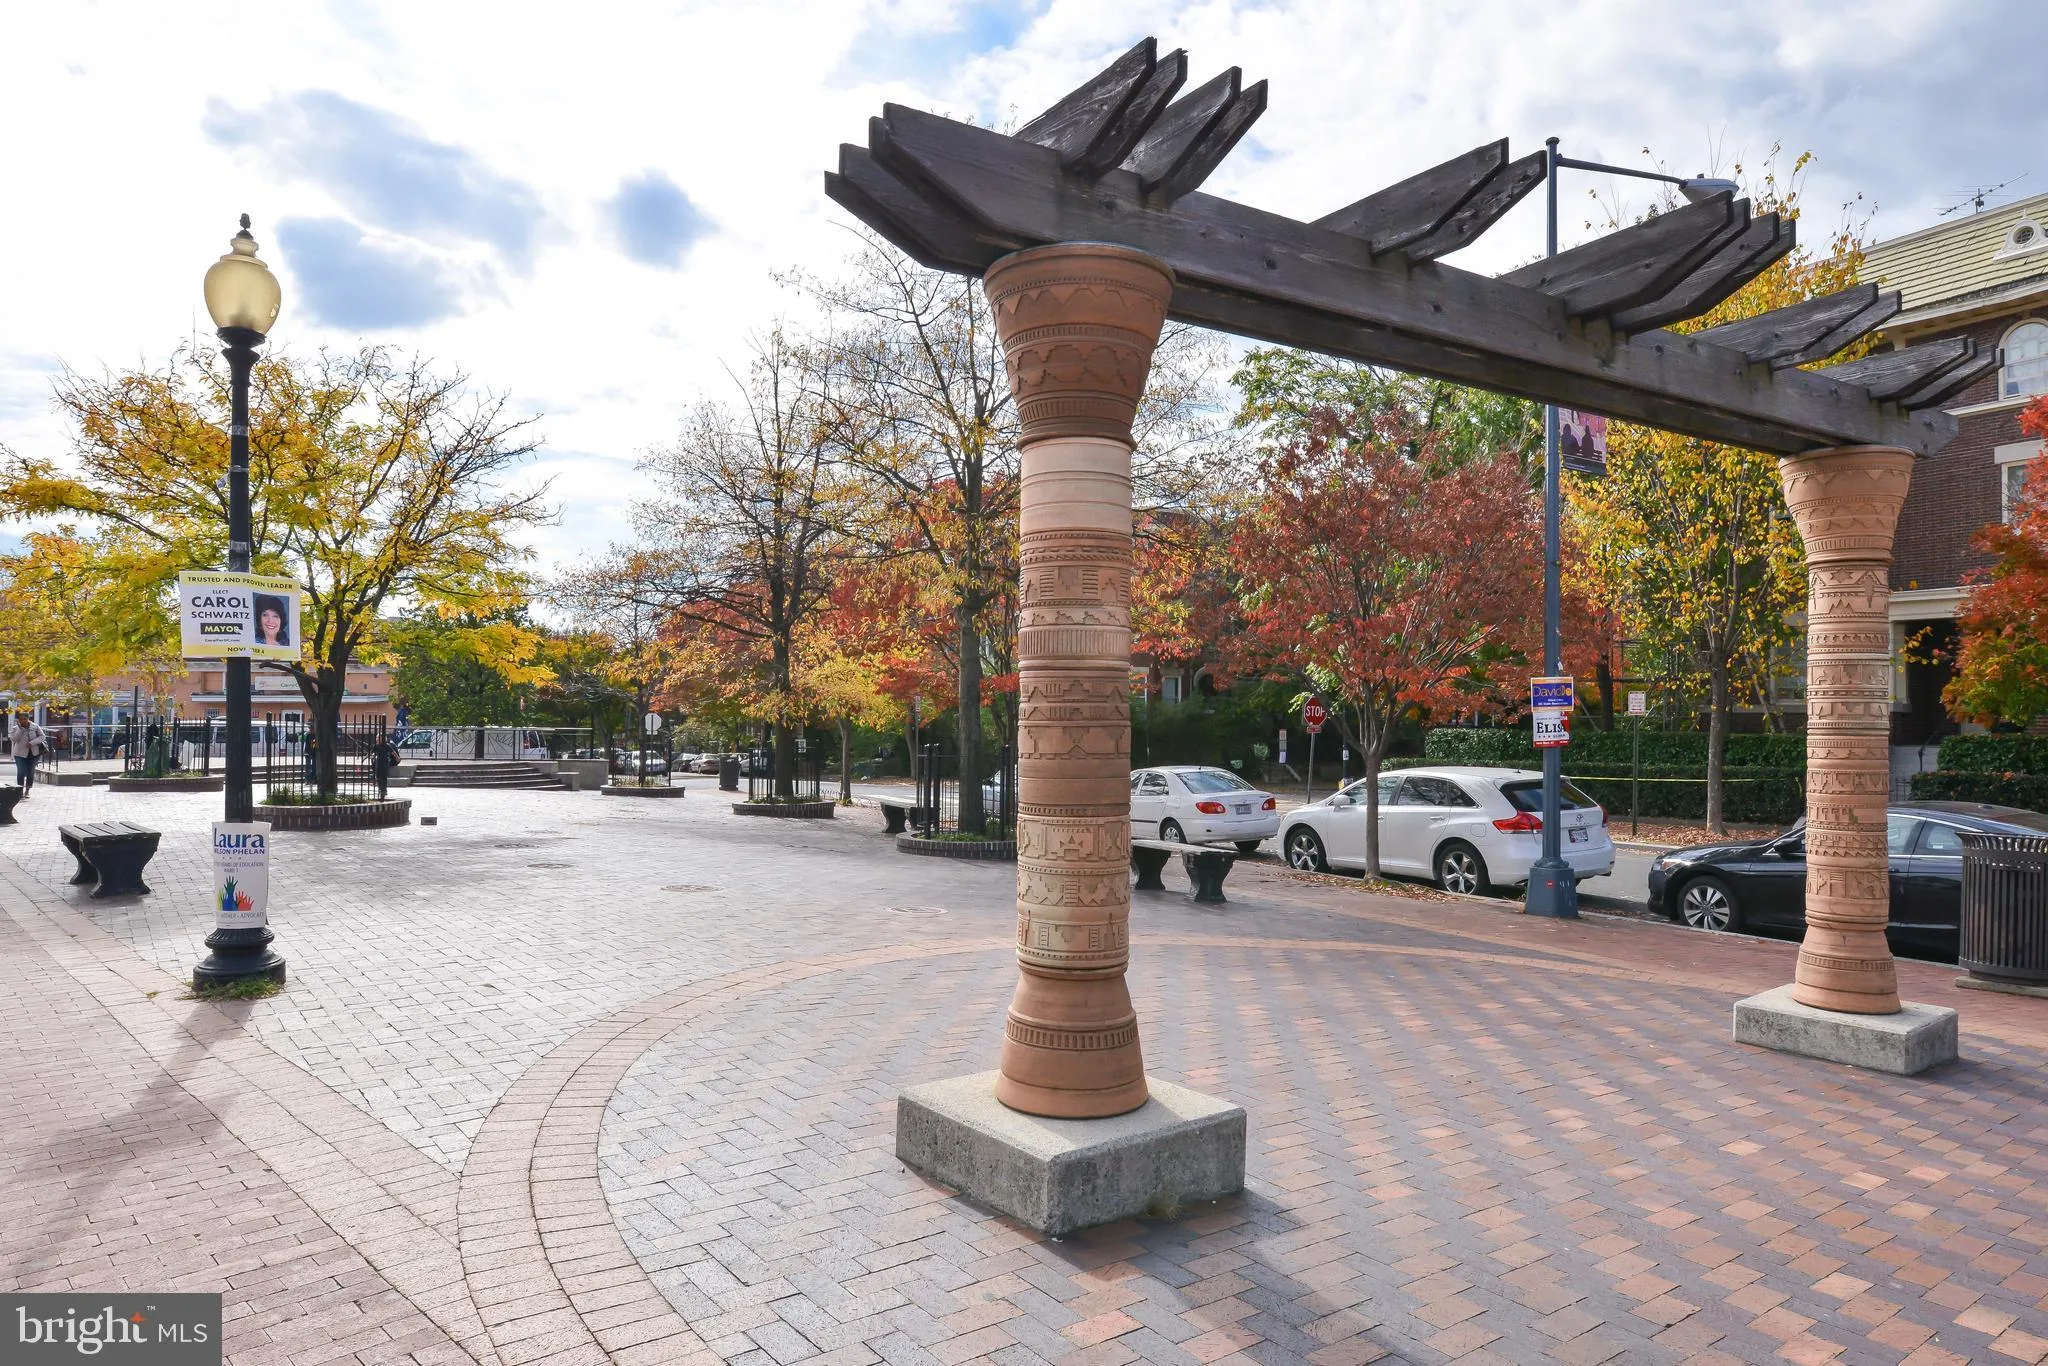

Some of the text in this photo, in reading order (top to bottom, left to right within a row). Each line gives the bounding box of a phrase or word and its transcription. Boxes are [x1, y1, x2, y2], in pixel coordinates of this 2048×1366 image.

[242, 578, 266, 587] PROVEN
[191, 596, 249, 609] CAROL
[191, 611, 250, 620] SCHWARTZ
[204, 625, 240, 634] MAYOR
